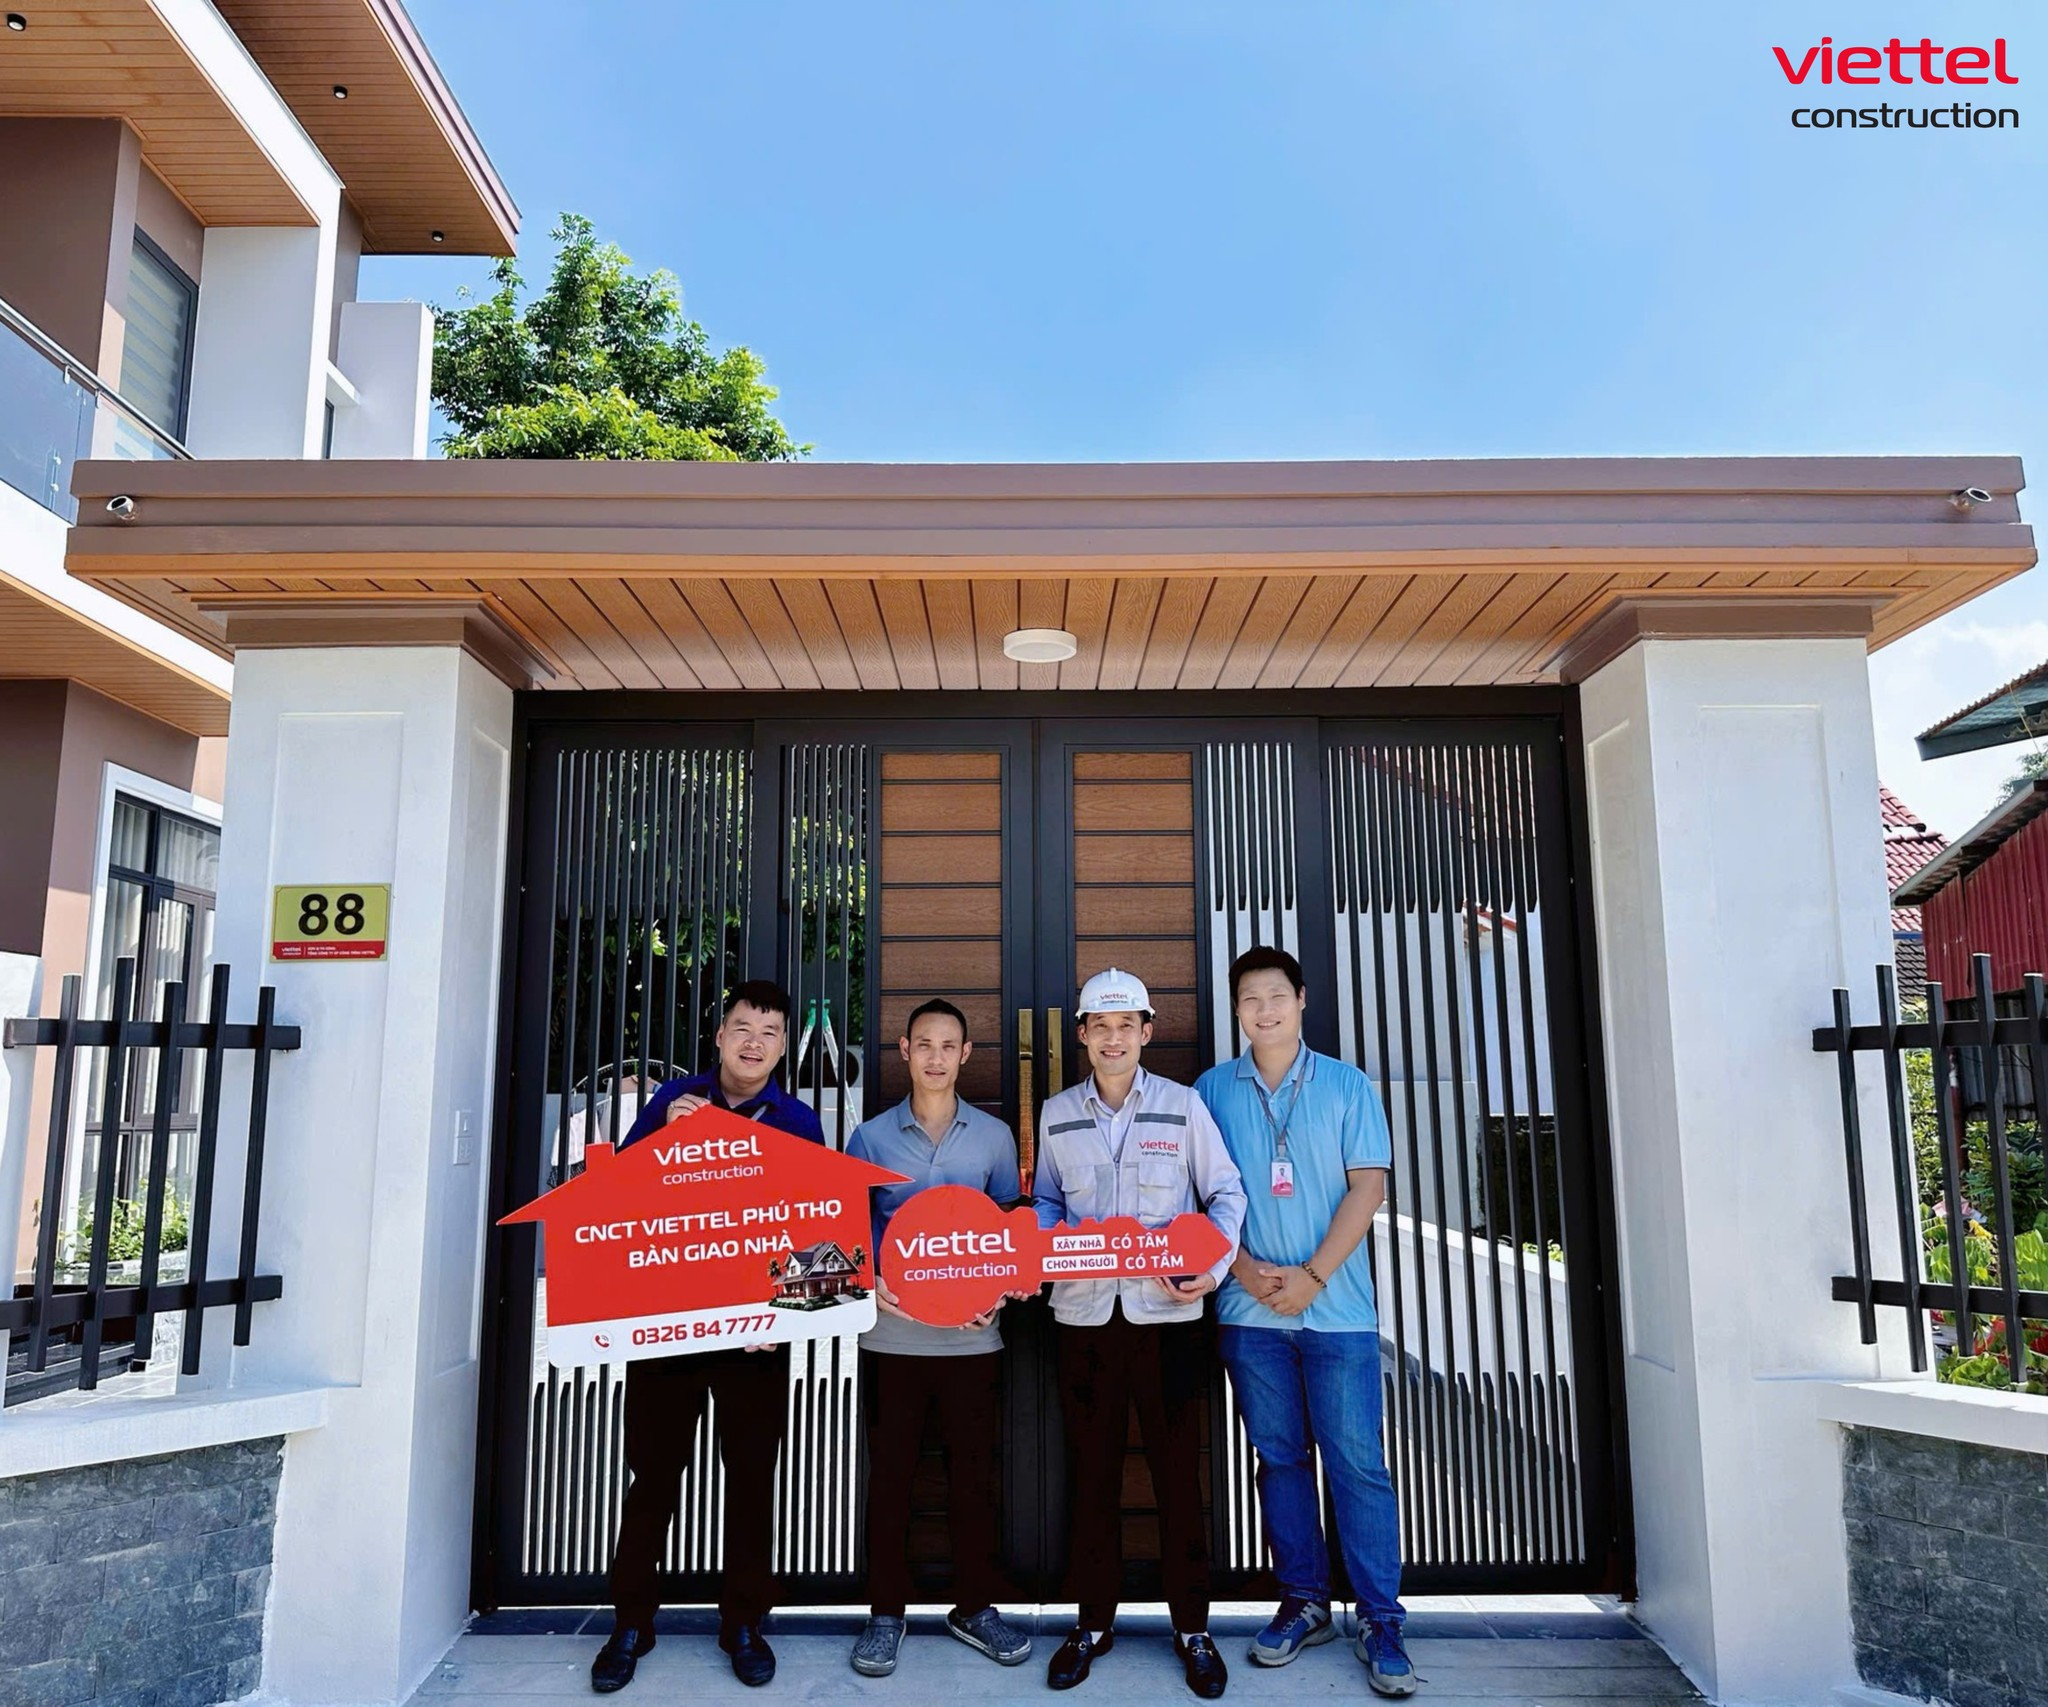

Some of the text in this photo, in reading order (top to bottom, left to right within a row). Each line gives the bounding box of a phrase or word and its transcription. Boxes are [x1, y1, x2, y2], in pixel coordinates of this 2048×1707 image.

[298, 893, 365, 936] 88
[1100, 992, 1128, 1000] viettel
[653, 1135, 763, 1166] viettel
[1139, 1141, 1179, 1152] viettel
[662, 1164, 764, 1185] construction
[575, 1199, 842, 1244] CNCT VIETTEL PHÚ THỌ
[628, 1229, 794, 1268] BÀN GIAO NHÀ
[895, 1228, 1017, 1259] viettel
[1056, 1231, 1168, 1250] XÂY NHÀ CÓ TÂM
[904, 1262, 1018, 1282] construction
[1080, 1256, 1114, 1269] NGƯỜI
[1125, 1253, 1146, 1270] CÓ
[1151, 1249, 1184, 1269] TẦM
[632, 1313, 776, 1345] 0326 84 7777
